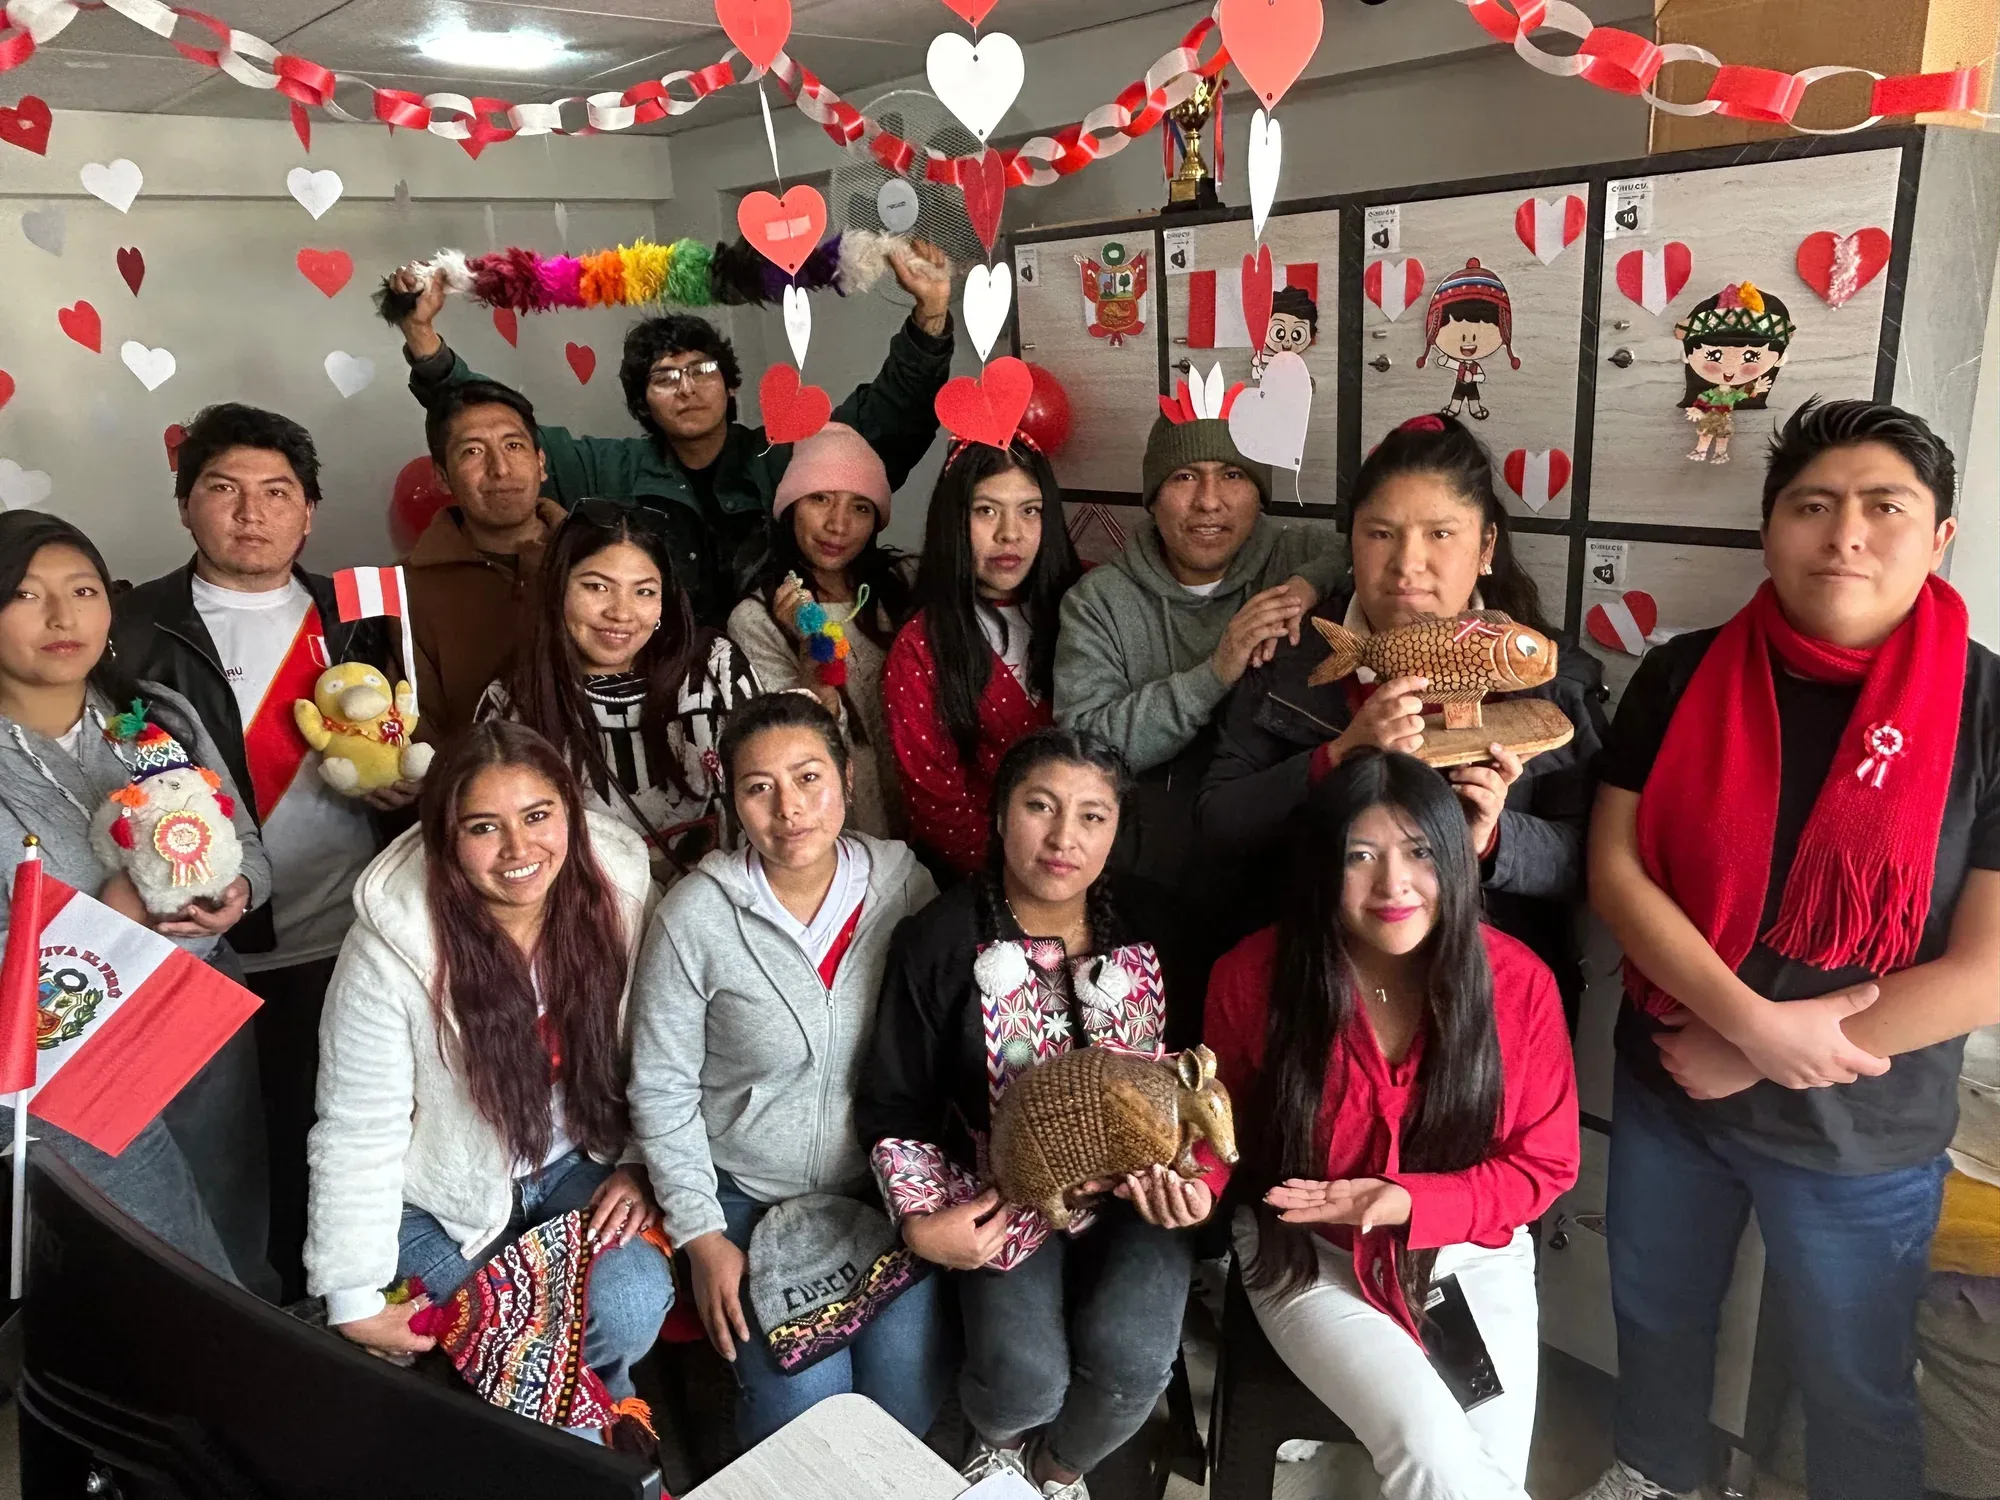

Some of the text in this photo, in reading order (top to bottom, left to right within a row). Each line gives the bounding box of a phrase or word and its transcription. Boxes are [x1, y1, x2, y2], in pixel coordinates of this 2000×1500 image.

[1623, 212, 1635, 223] 10
[1601, 569, 1611, 578] 12
[80, 949, 101, 967] EL
[781, 1261, 858, 1314] CUSCO
